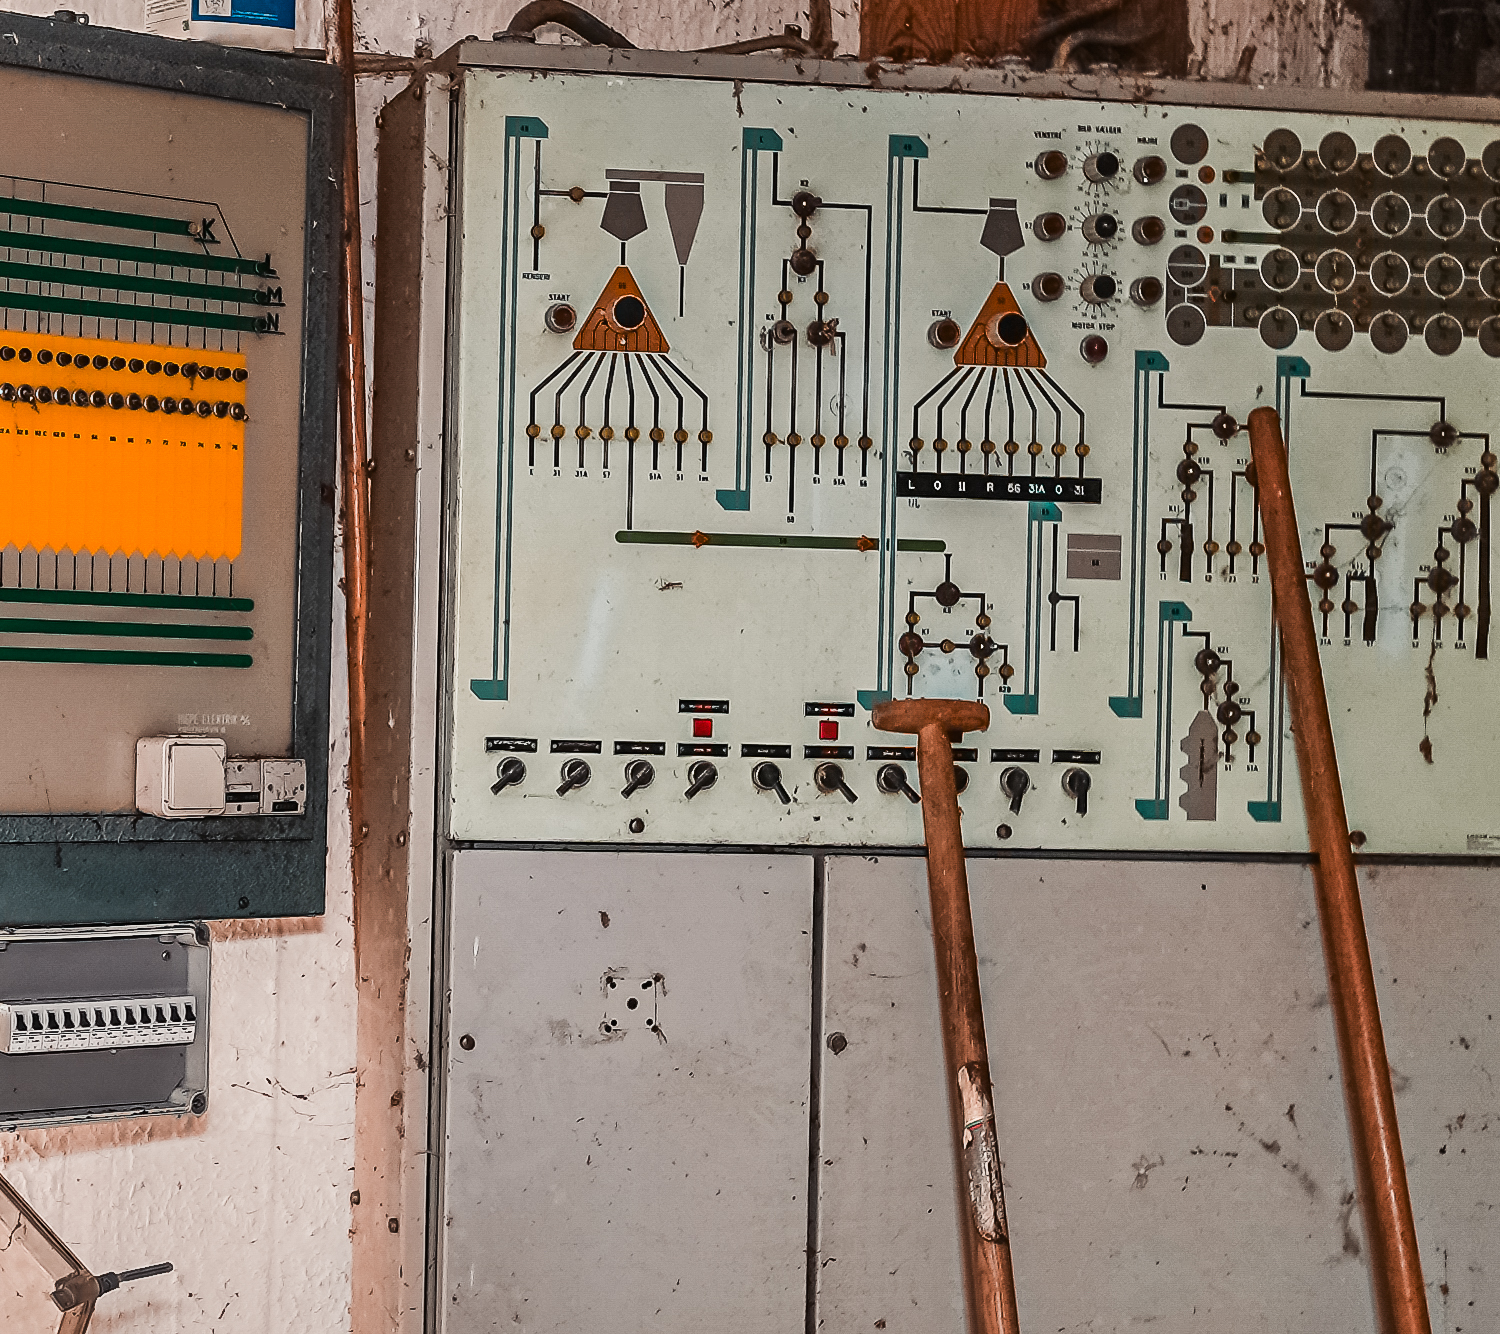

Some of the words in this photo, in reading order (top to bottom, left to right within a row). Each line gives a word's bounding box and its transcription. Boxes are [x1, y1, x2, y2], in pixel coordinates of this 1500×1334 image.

[202, 217, 216, 240] K
[266, 285, 283, 303] M
[548, 293, 571, 302] START
[931, 309, 952, 318] START
[266, 312, 280, 331] N
[1072, 321, 1097, 331] MOTOR
[1098, 323, 1116, 331] STOP
[574, 470, 589, 479] 31A
[908, 479, 916, 490] L
[986, 481, 995, 493] R
[1028, 483, 1046, 495] 31A
[1074, 485, 1086, 496] 31
